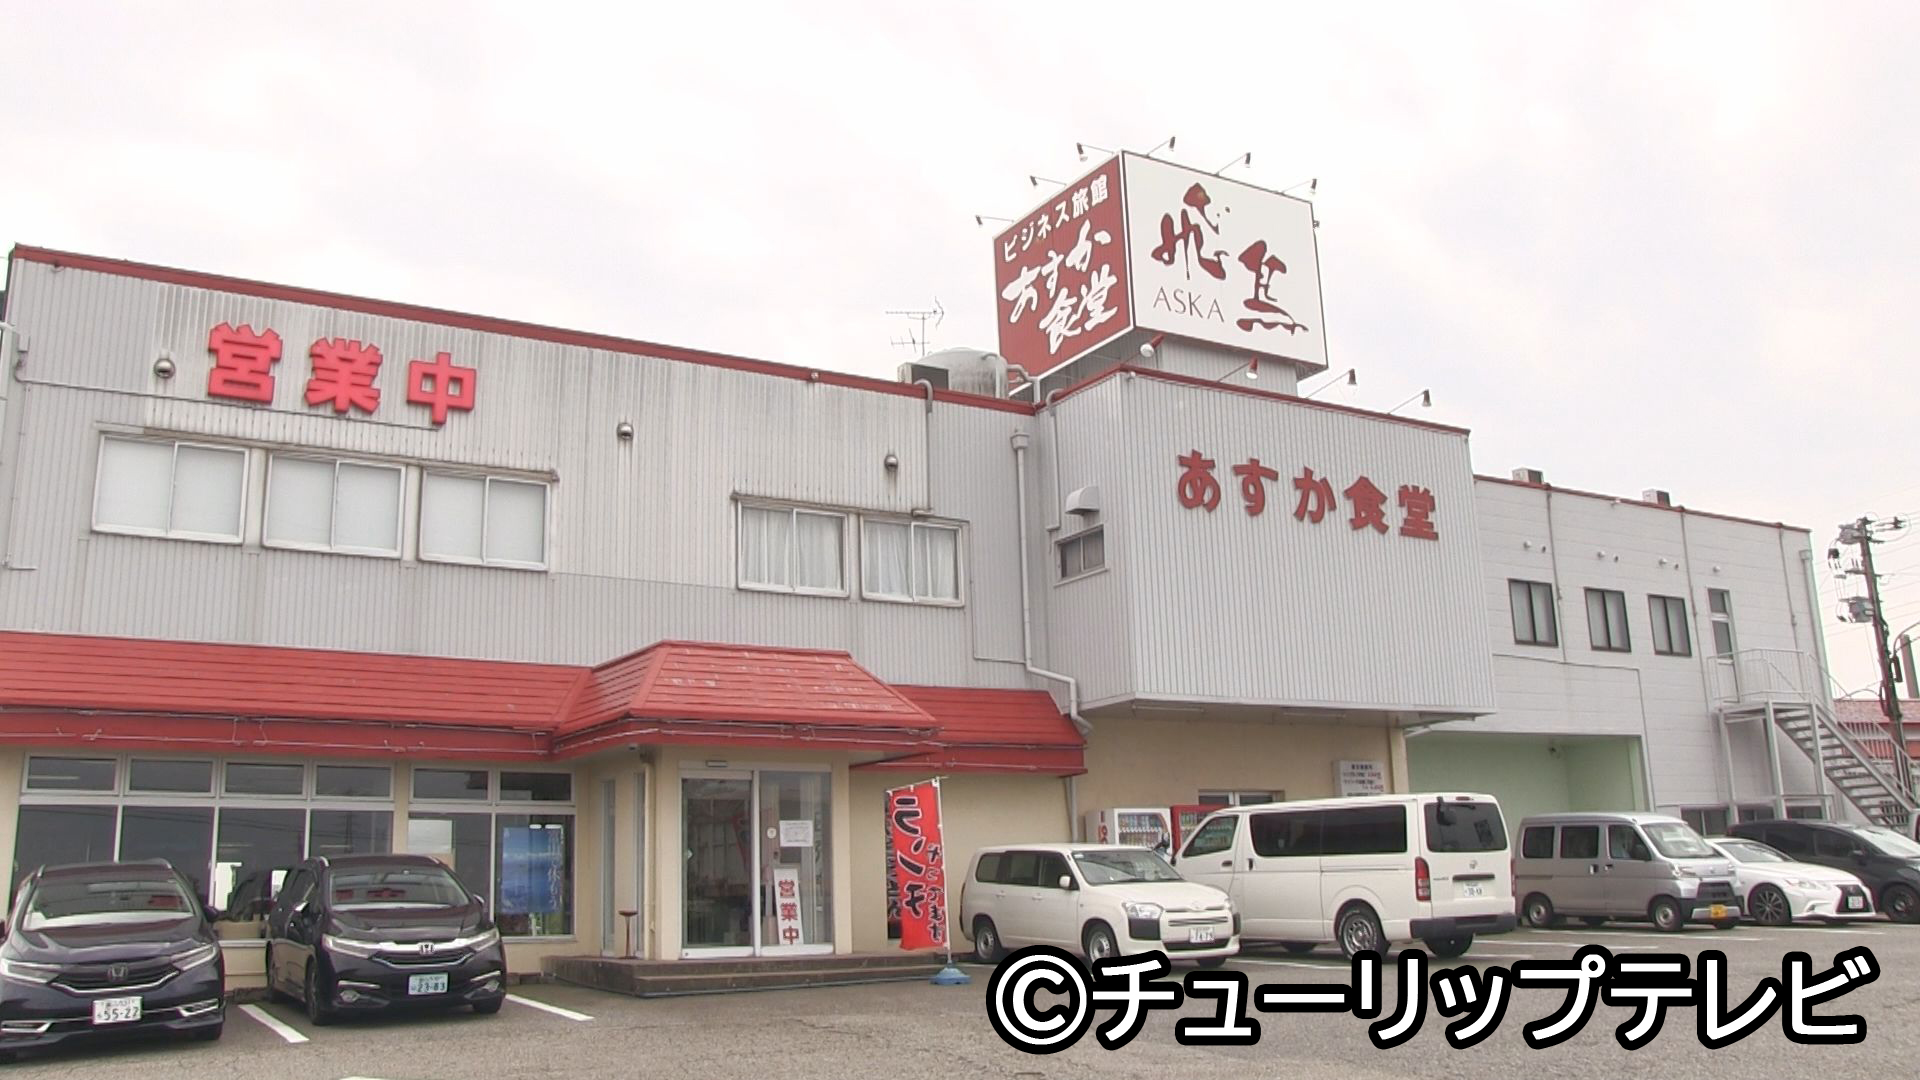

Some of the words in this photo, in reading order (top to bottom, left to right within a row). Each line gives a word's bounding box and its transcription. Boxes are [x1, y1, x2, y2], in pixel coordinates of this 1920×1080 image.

[1004, 174, 1109, 262] ビジネス旅館
[1001, 219, 1112, 323] あすか
[1039, 264, 1118, 355] 食堂
[1152, 285, 1225, 323] ASKA
[207, 321, 477, 425] 営業中
[1177, 448, 1440, 542] あすか食堂
[893, 796, 926, 919] ランチ
[778, 879, 800, 946] 営業中
